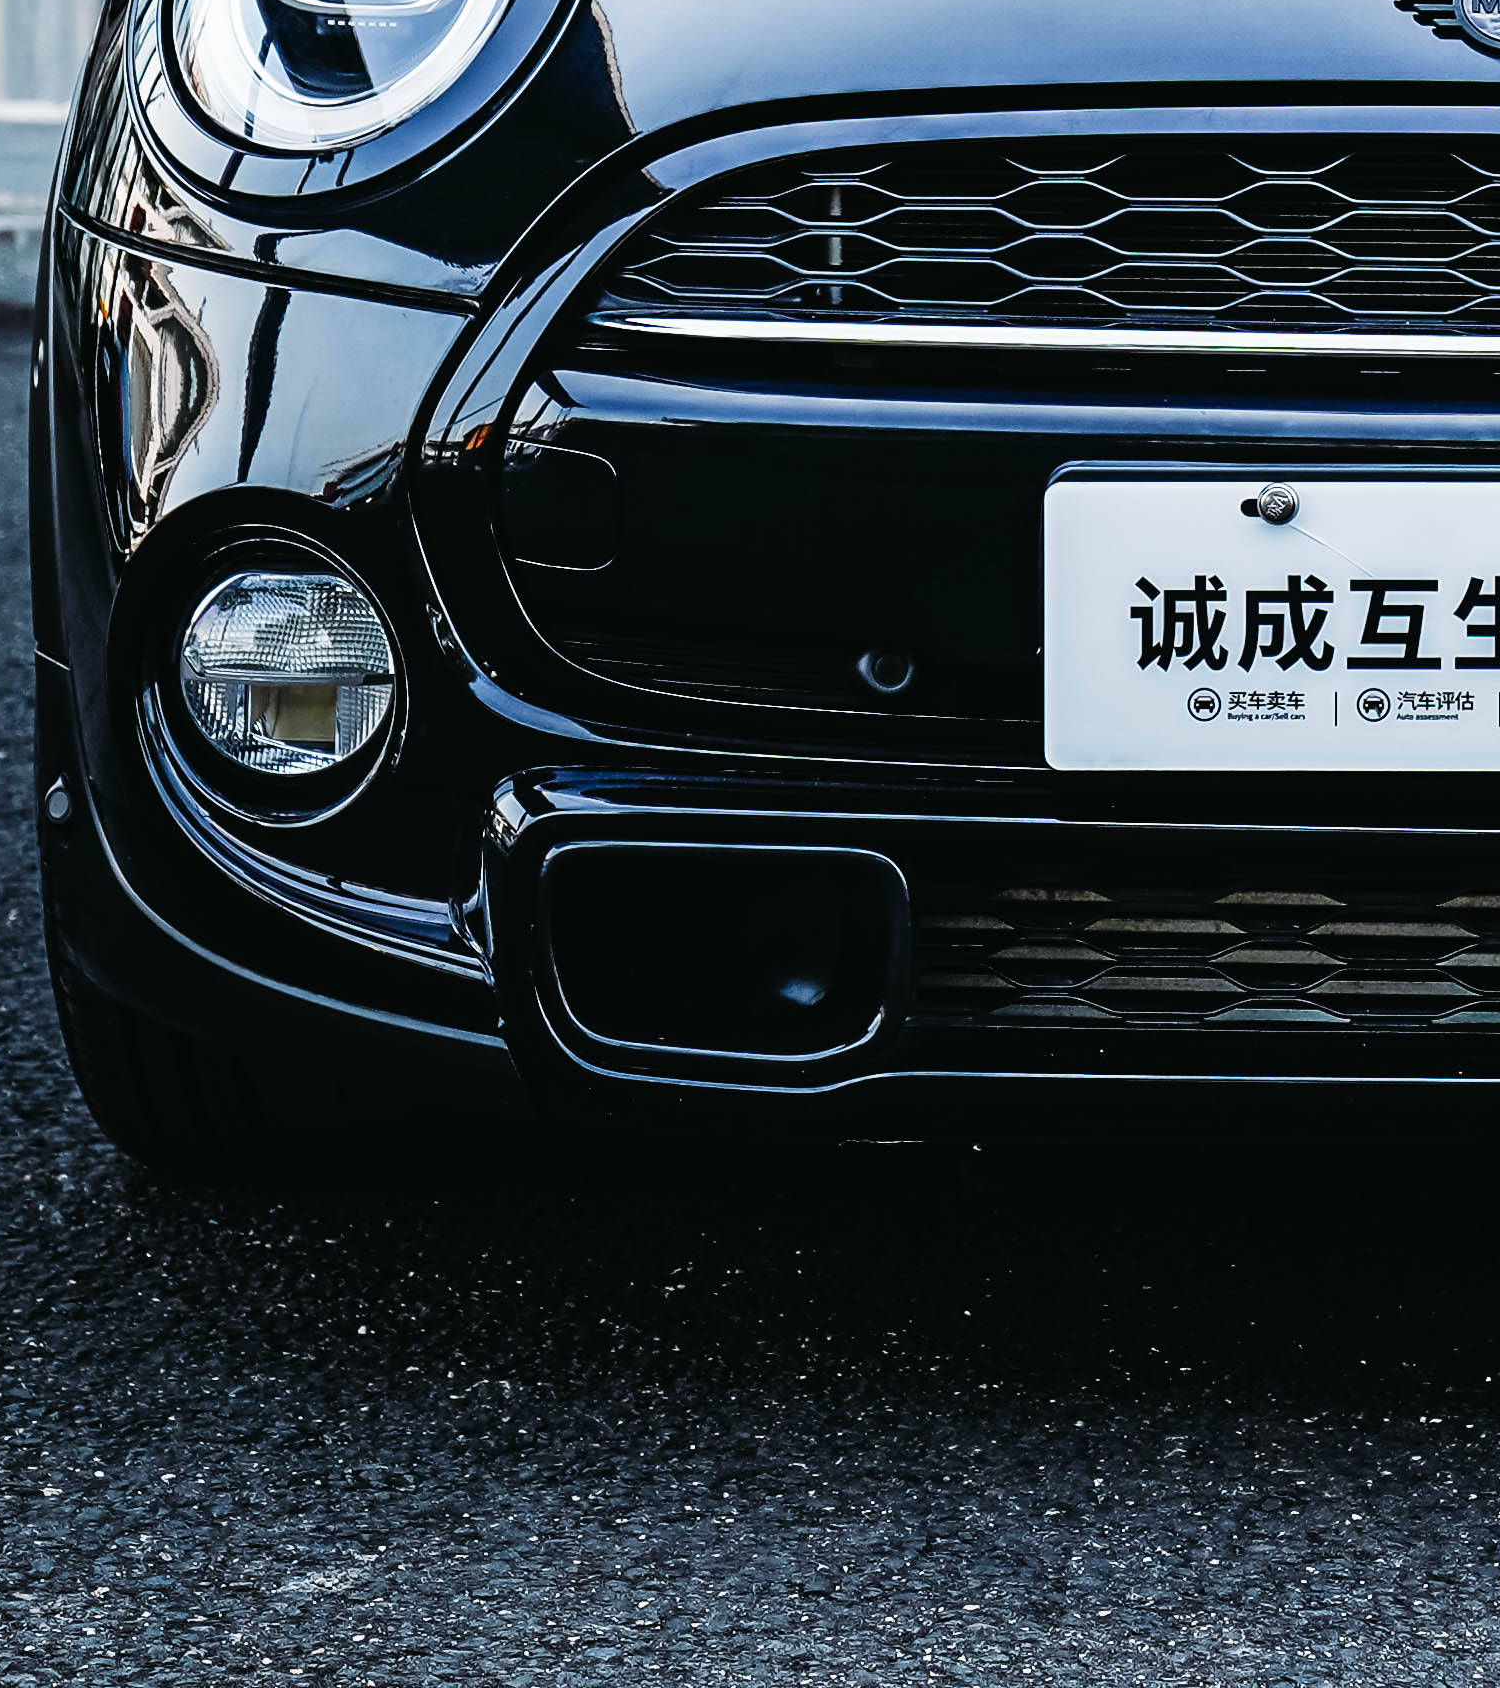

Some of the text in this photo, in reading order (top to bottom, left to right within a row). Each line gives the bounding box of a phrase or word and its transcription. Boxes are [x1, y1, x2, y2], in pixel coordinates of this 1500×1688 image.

[1228, 690, 1306, 711] 买车卖车
[1397, 690, 1475, 711] 汽车评估
